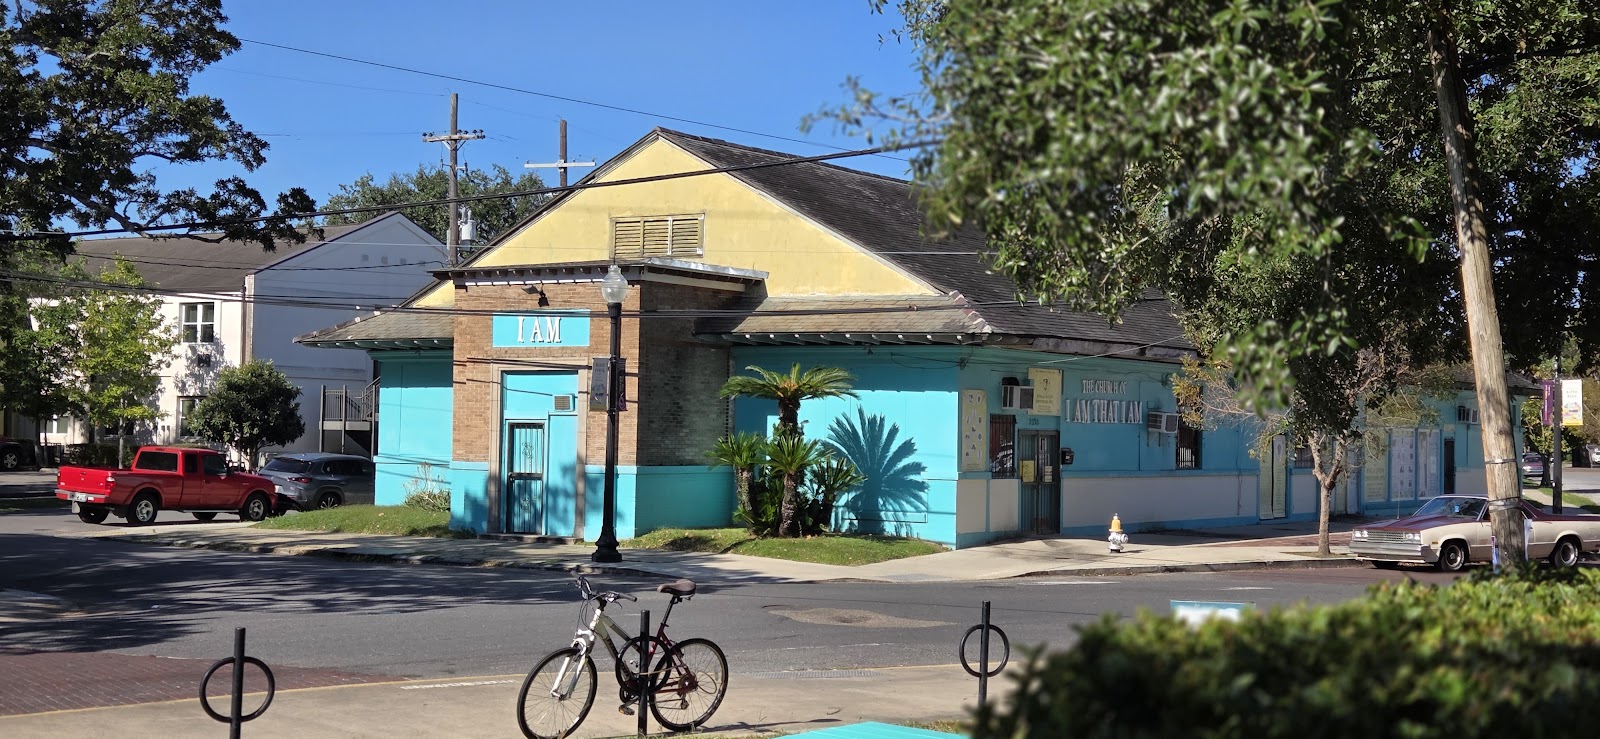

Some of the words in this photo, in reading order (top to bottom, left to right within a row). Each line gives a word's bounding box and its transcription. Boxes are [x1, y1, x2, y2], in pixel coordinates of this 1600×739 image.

[517, 316, 525, 343] I
[530, 316, 562, 343] AM
[1082, 380, 1094, 394] THE
[1095, 380, 1119, 395] CHURCH
[1120, 381, 1127, 395] OF
[1065, 400, 1071, 422] I
[1073, 400, 1091, 424] AM
[1092, 400, 1119, 424] THAT
[1121, 401, 1126, 424] I
[1127, 401, 1143, 424] AM
